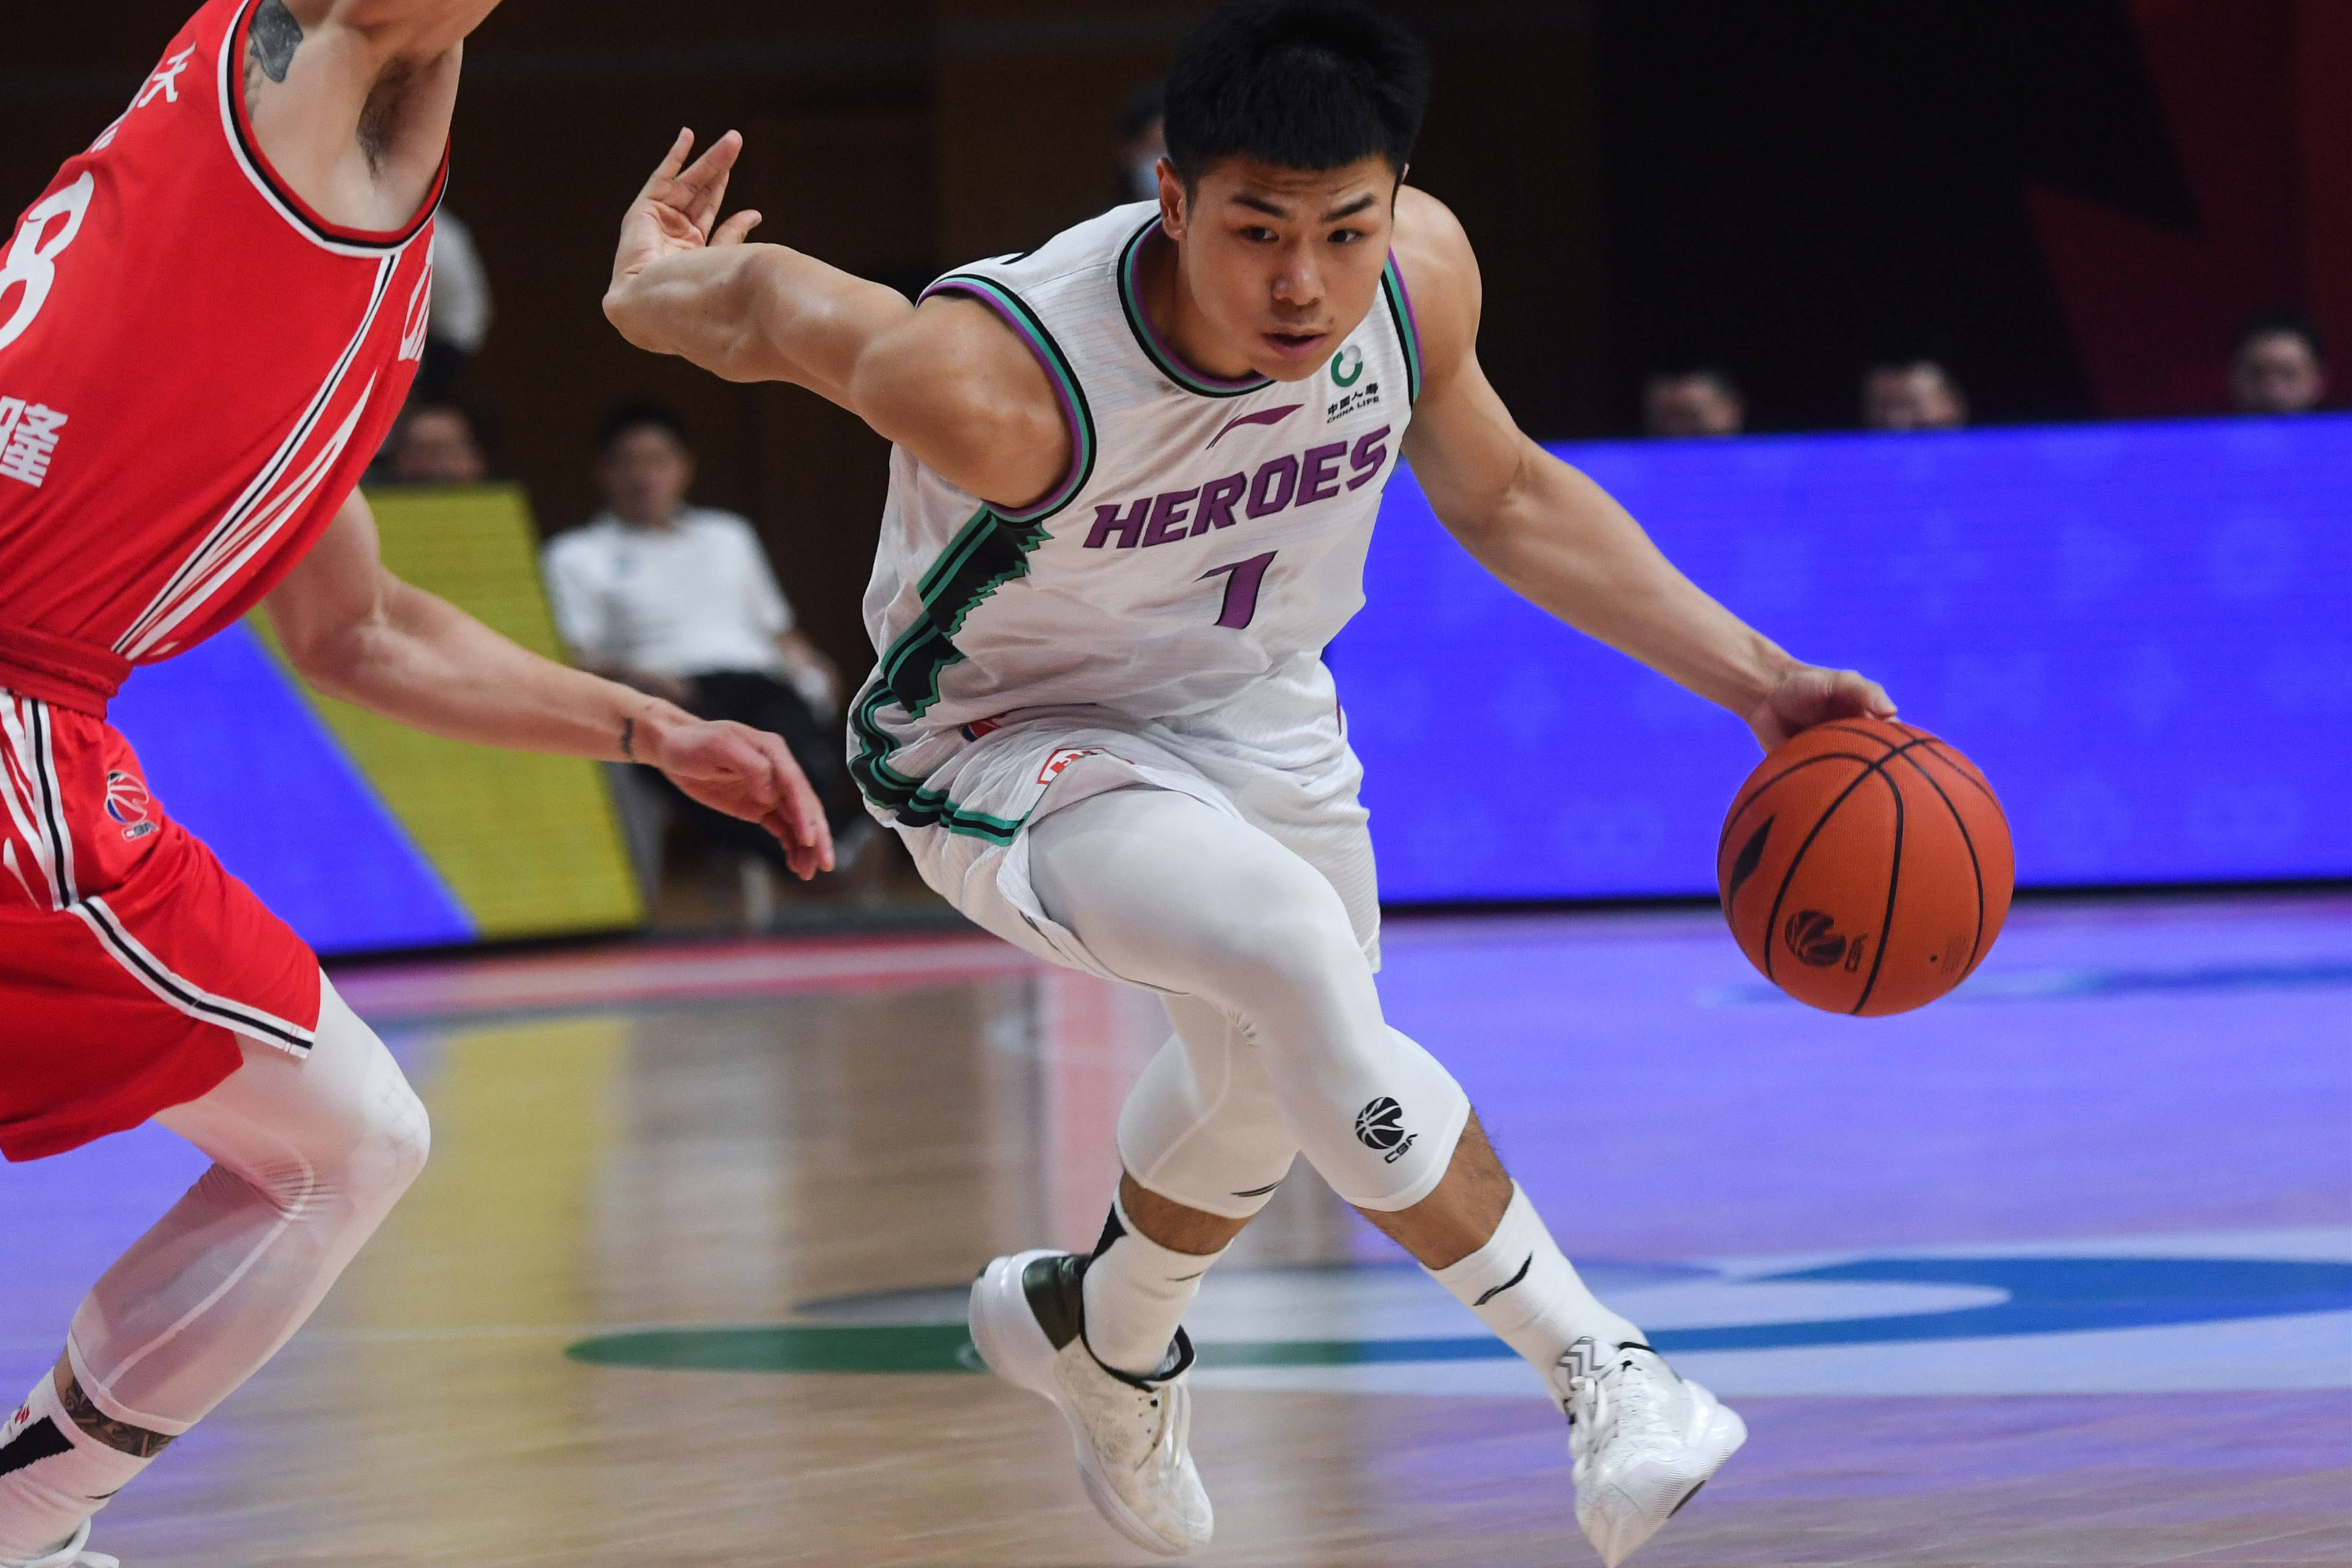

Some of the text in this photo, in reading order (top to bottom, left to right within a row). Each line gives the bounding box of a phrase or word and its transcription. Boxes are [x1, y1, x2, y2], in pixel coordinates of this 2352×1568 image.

[1326, 395, 1379, 424] CHINA LIFE
[1082, 424, 1391, 549] HEROES
[1193, 550, 1279, 630] 7
